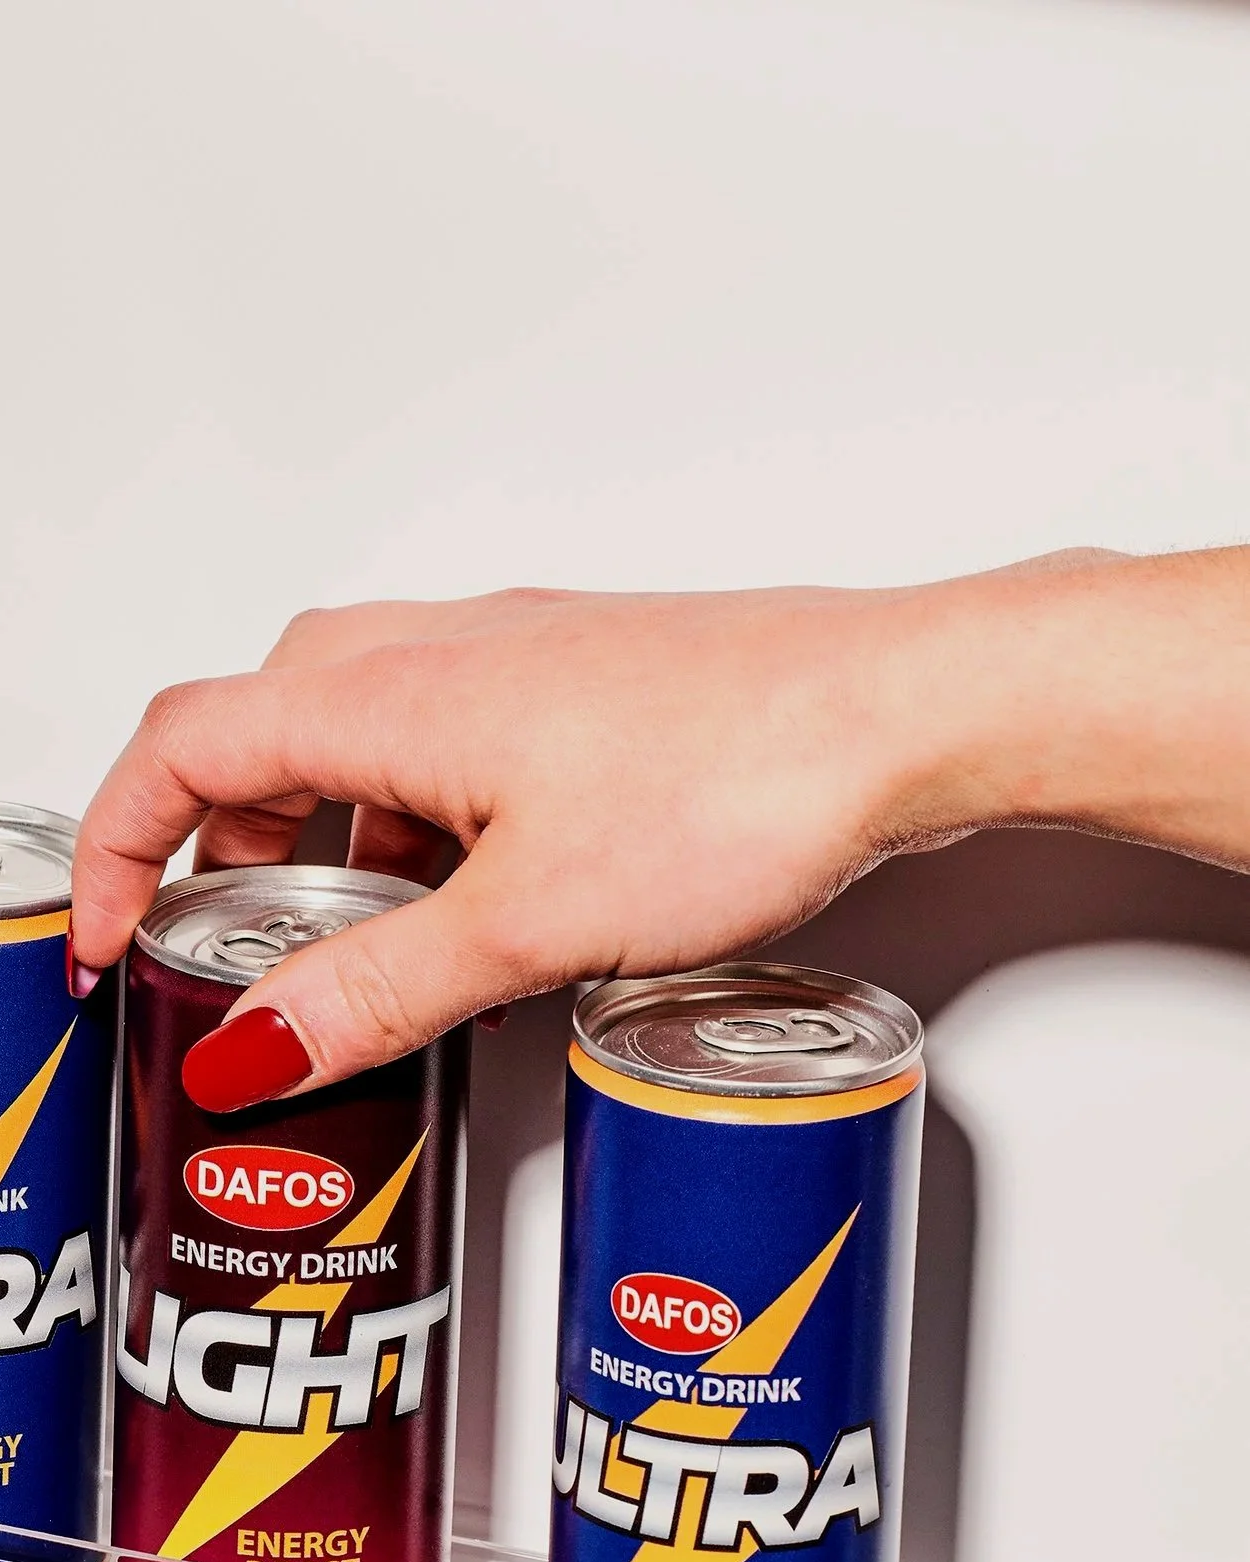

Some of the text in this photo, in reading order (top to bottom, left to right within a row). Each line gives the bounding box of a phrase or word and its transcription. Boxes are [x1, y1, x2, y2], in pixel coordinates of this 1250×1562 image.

[196, 1159, 348, 1208] DAFOS
[171, 1233, 398, 1280] ENERGY DRINK
[619, 1285, 735, 1339] DAFOS
[115, 1261, 451, 1429] LIGHT
[590, 1347, 802, 1403] ENERGY DRINK
[237, 1526, 370, 1558] ENERGY
